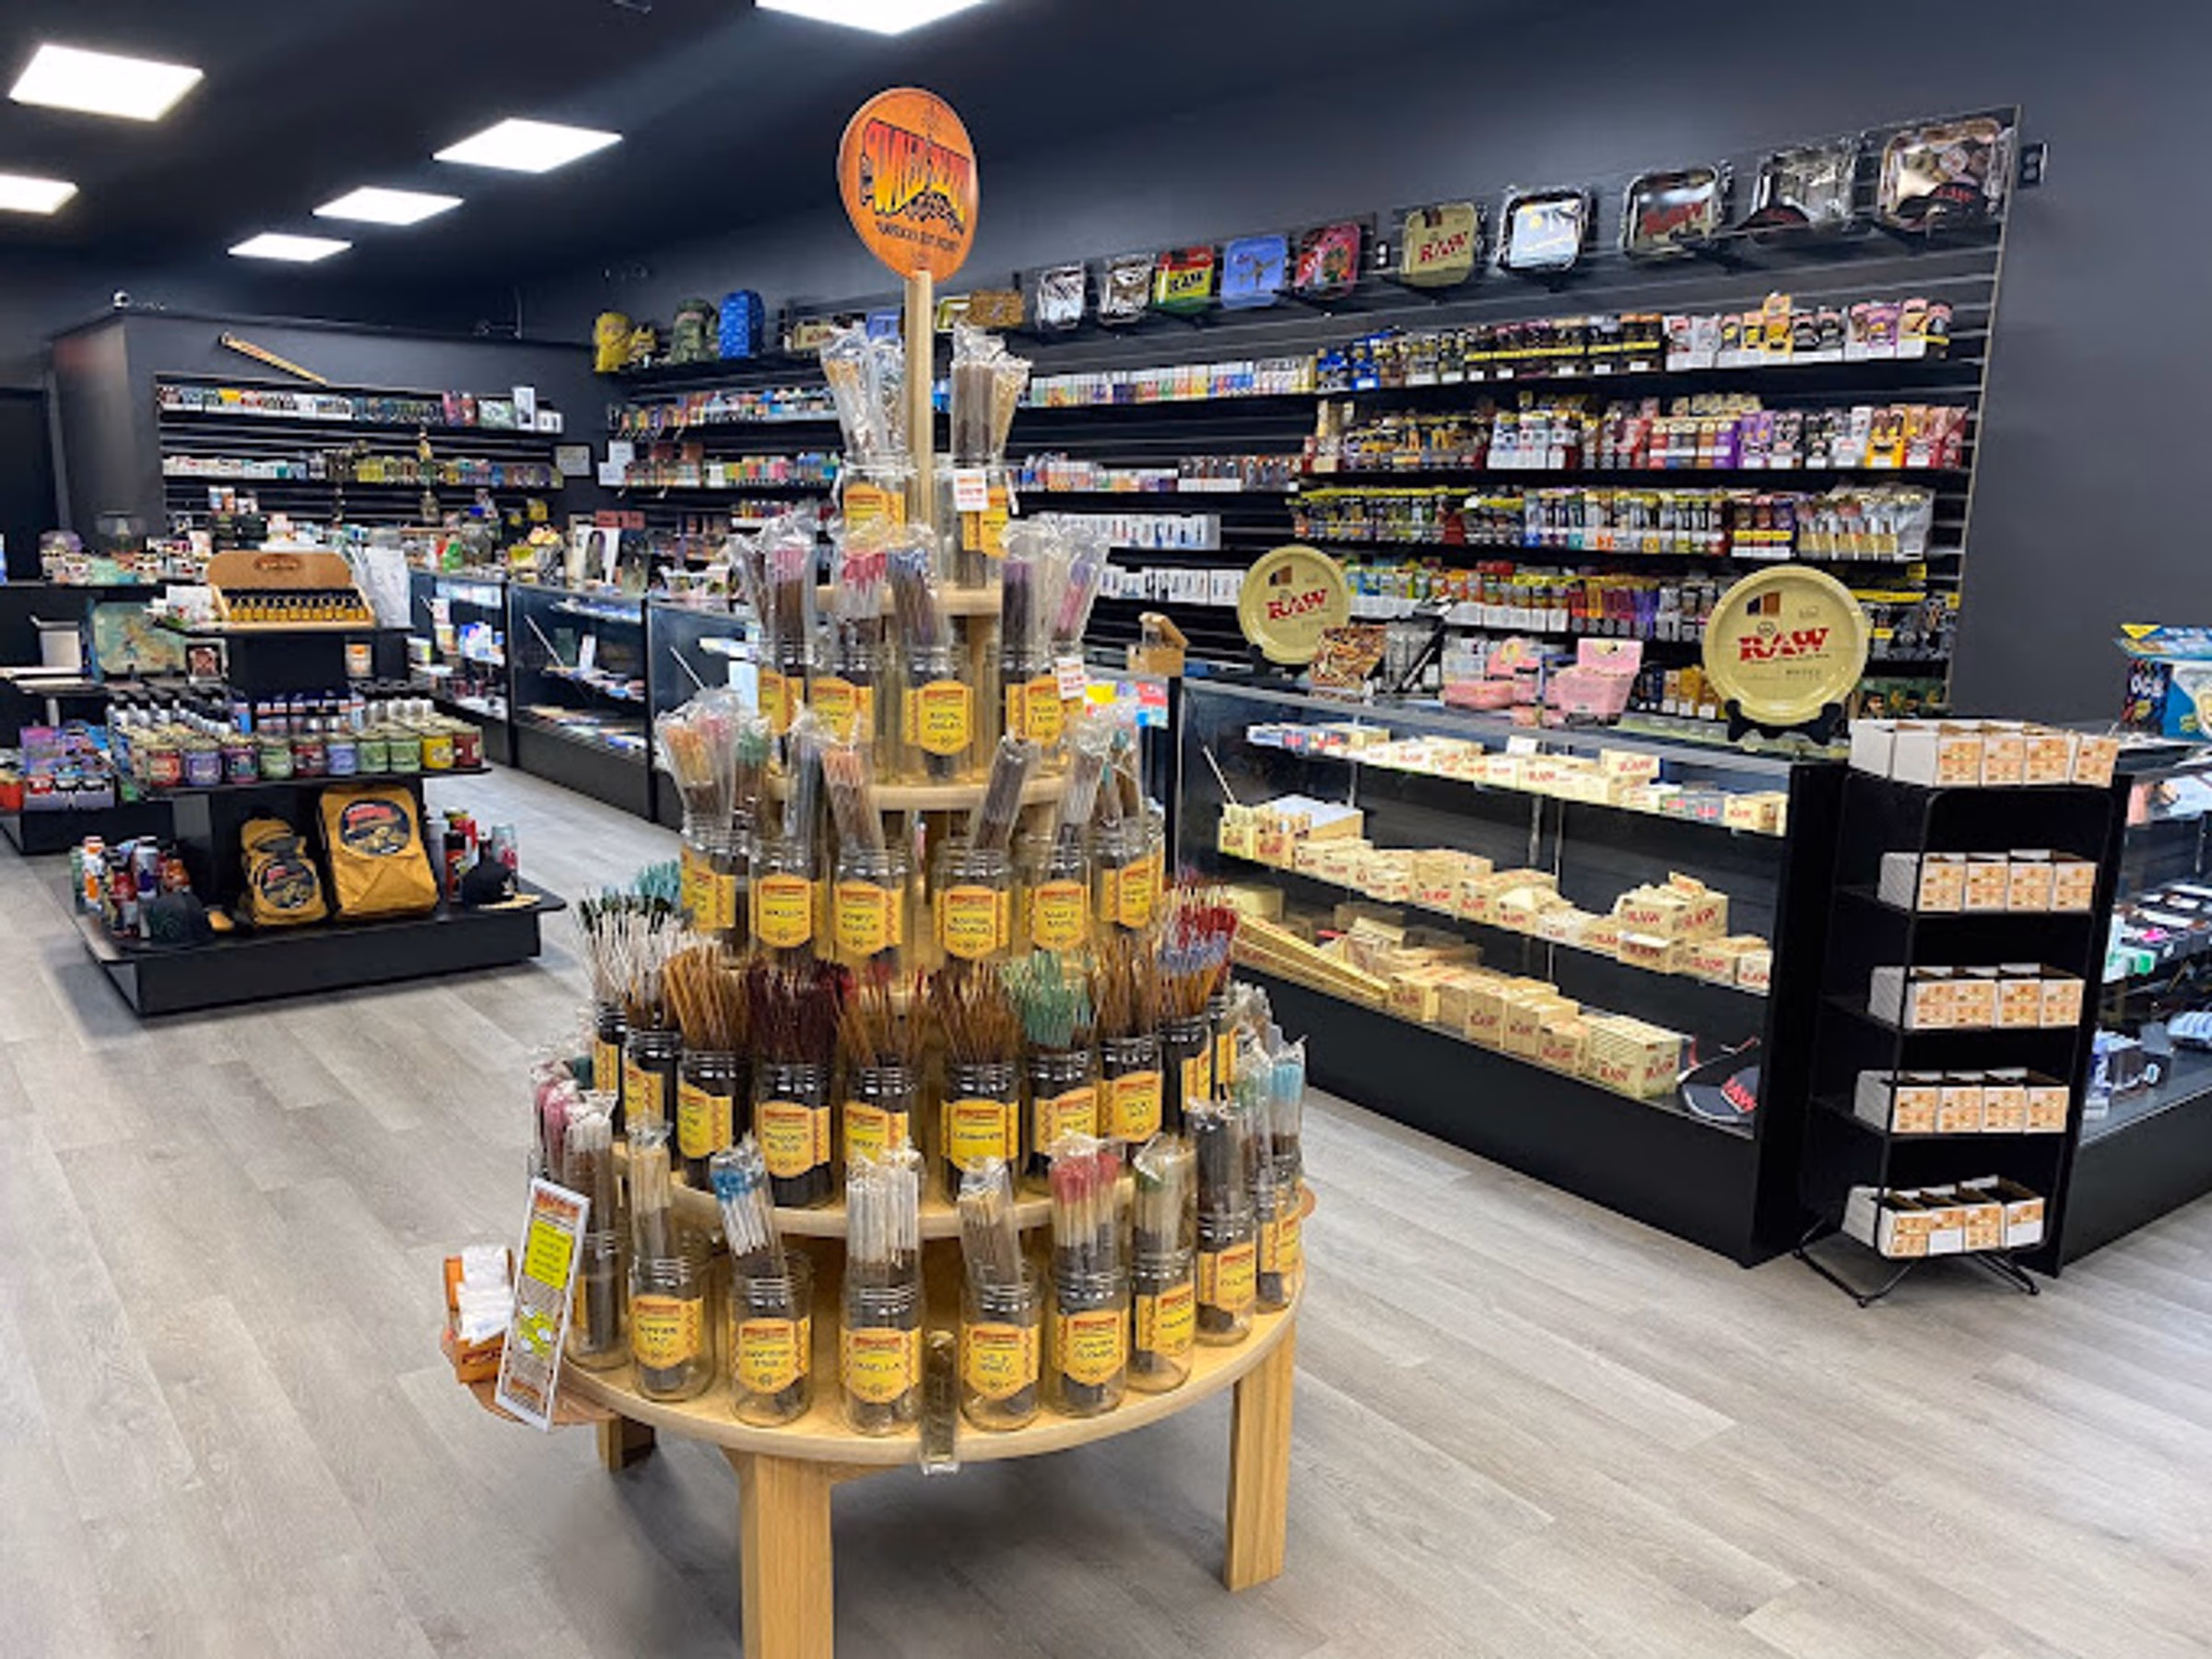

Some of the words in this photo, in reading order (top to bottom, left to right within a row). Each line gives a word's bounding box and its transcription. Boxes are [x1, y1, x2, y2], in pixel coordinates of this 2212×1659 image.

[1419, 231, 1468, 262] RAW
[1169, 272, 1205, 293] RAW
[1266, 588, 1327, 620] RAW
[1738, 627, 1830, 662] RAW
